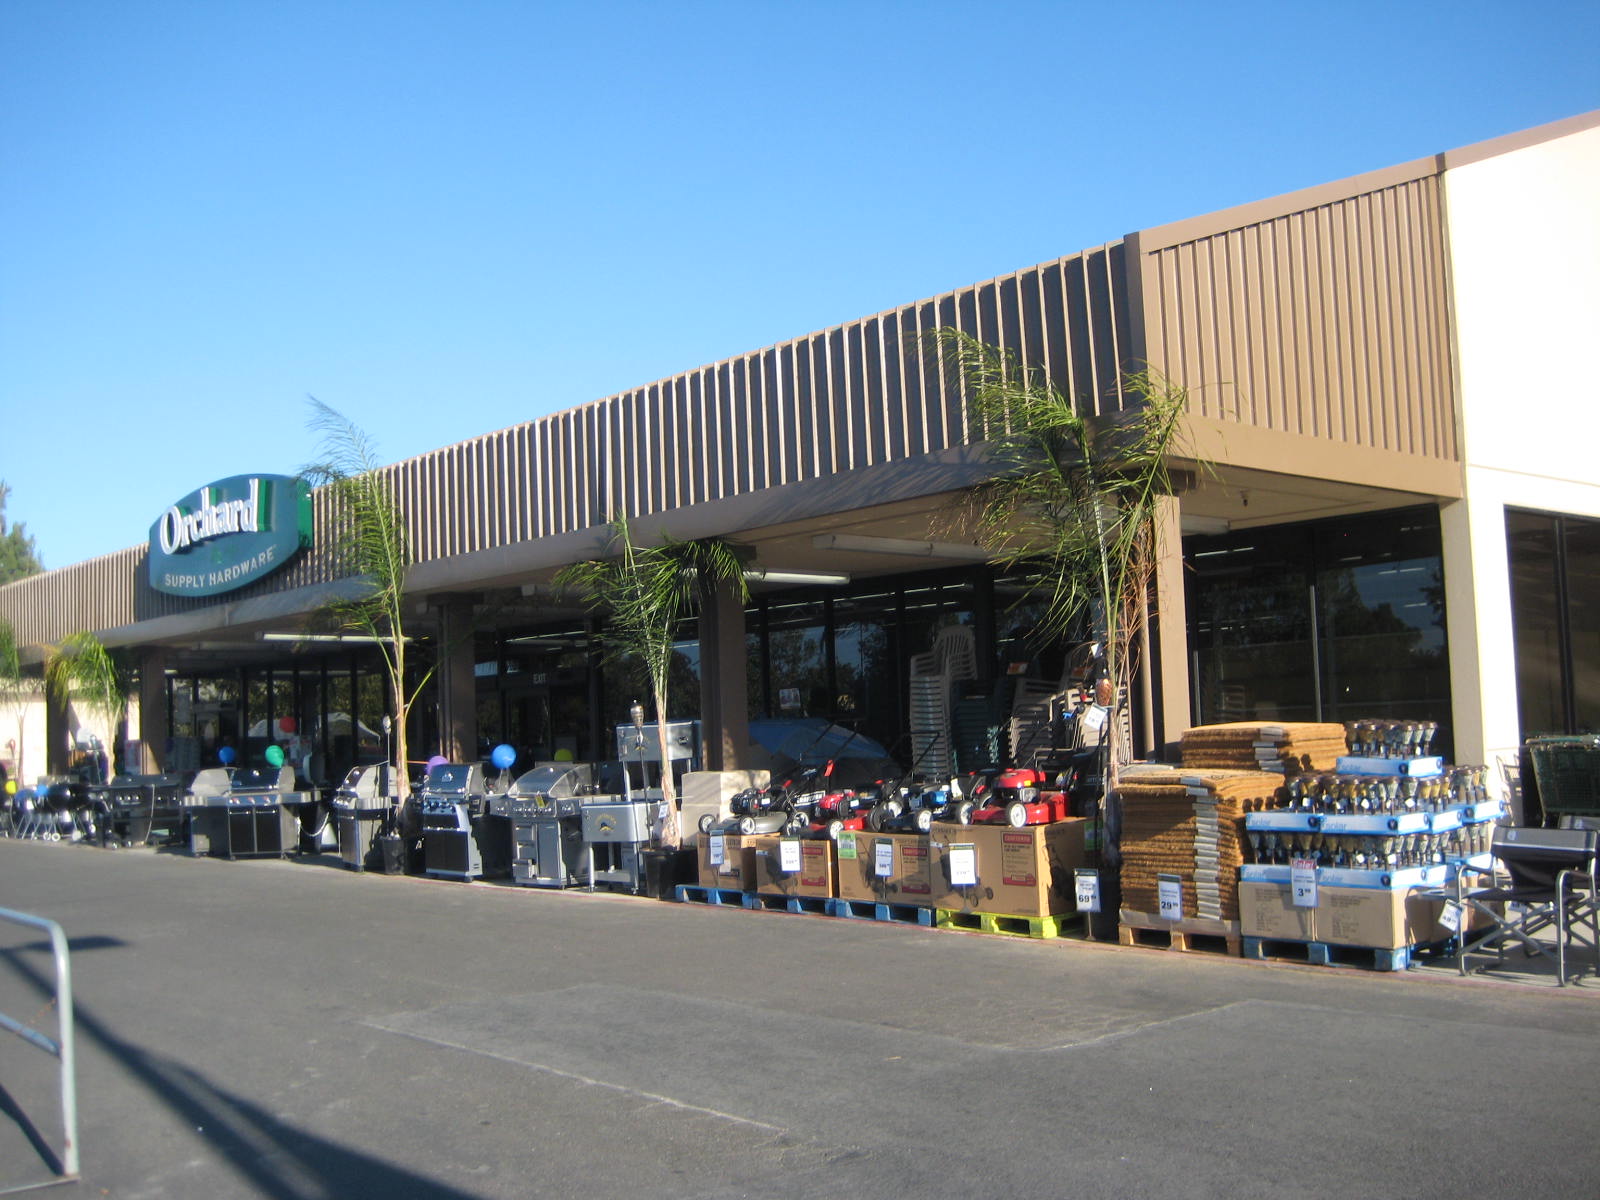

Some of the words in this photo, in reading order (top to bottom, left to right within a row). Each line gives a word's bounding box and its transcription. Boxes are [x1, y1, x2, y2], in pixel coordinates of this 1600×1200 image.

[160, 478, 259, 555] Orchard
[165, 573, 206, 588] SUPPLY
[209, 547, 274, 586] HARDWARE
